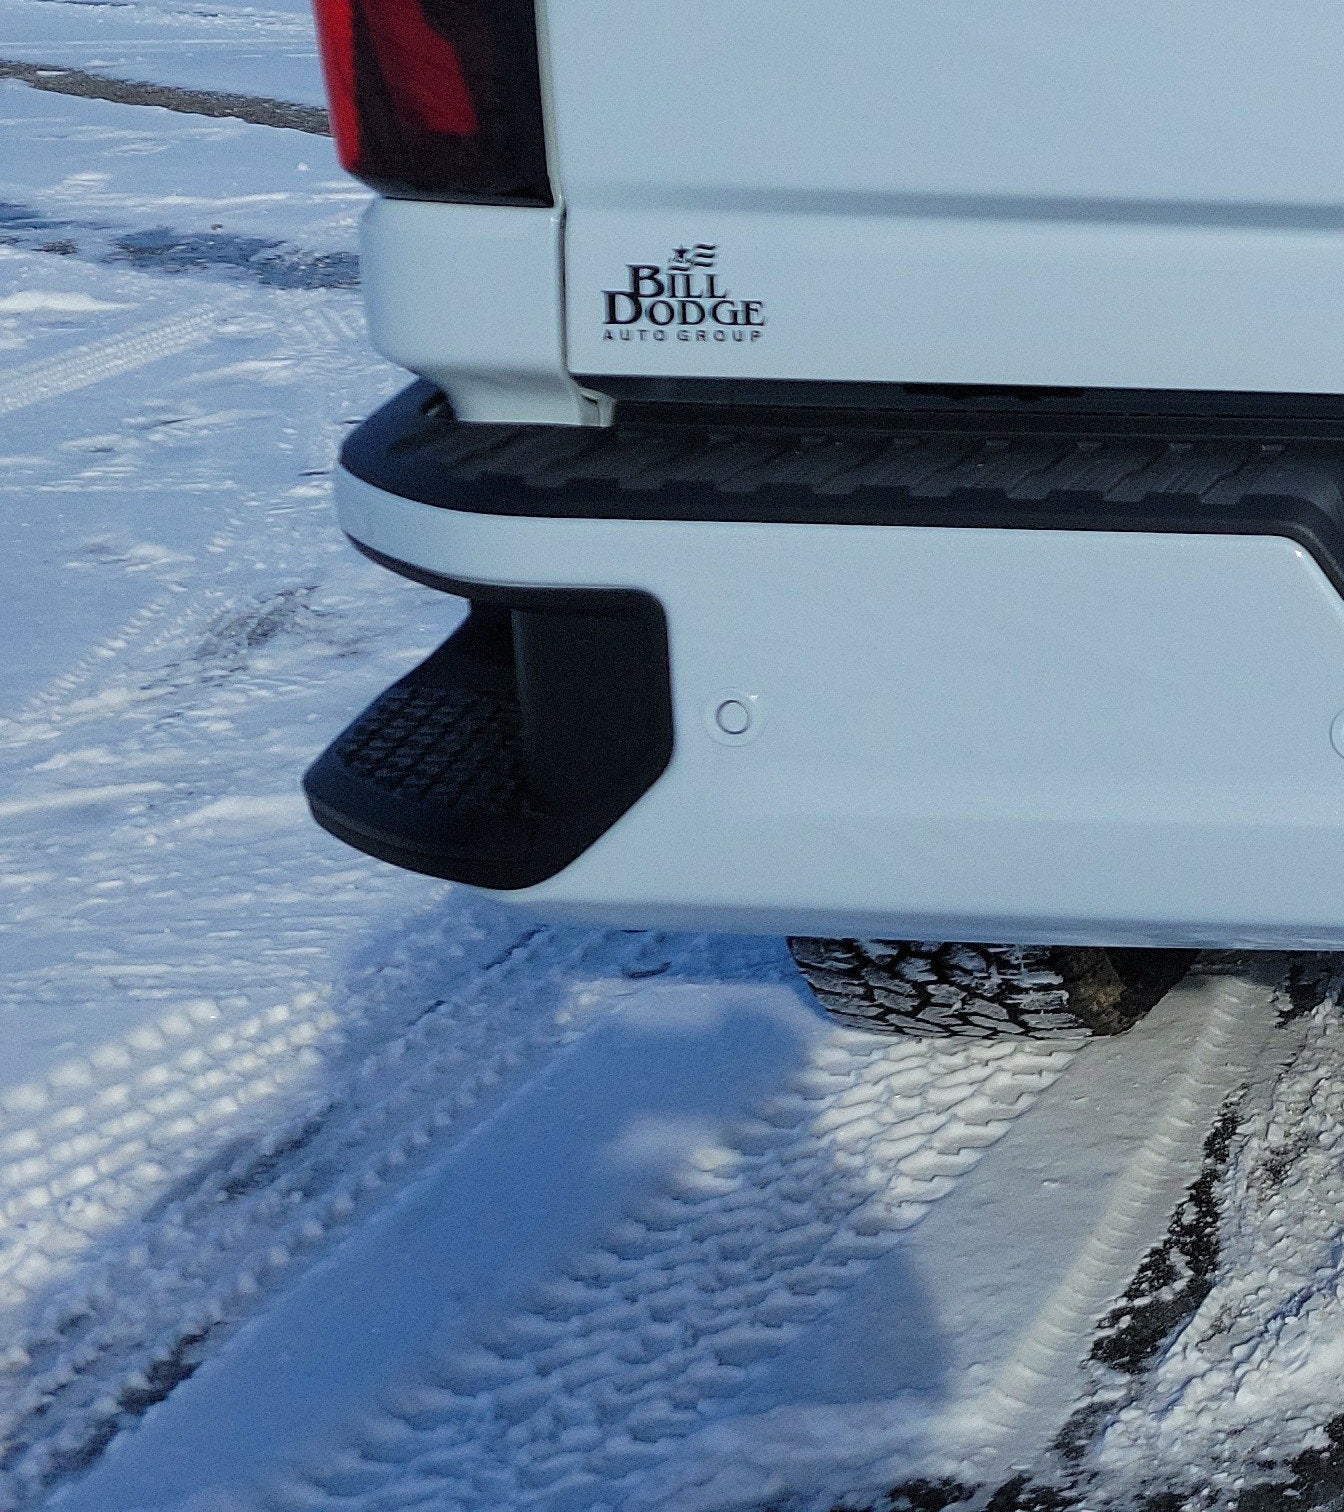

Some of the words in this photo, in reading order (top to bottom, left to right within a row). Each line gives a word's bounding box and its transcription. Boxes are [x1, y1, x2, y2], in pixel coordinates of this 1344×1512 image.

[626, 264, 727, 299] BILL
[601, 290, 766, 326] DODGE
[602, 329, 667, 342] AUTO
[676, 329, 764, 343] GROUP
